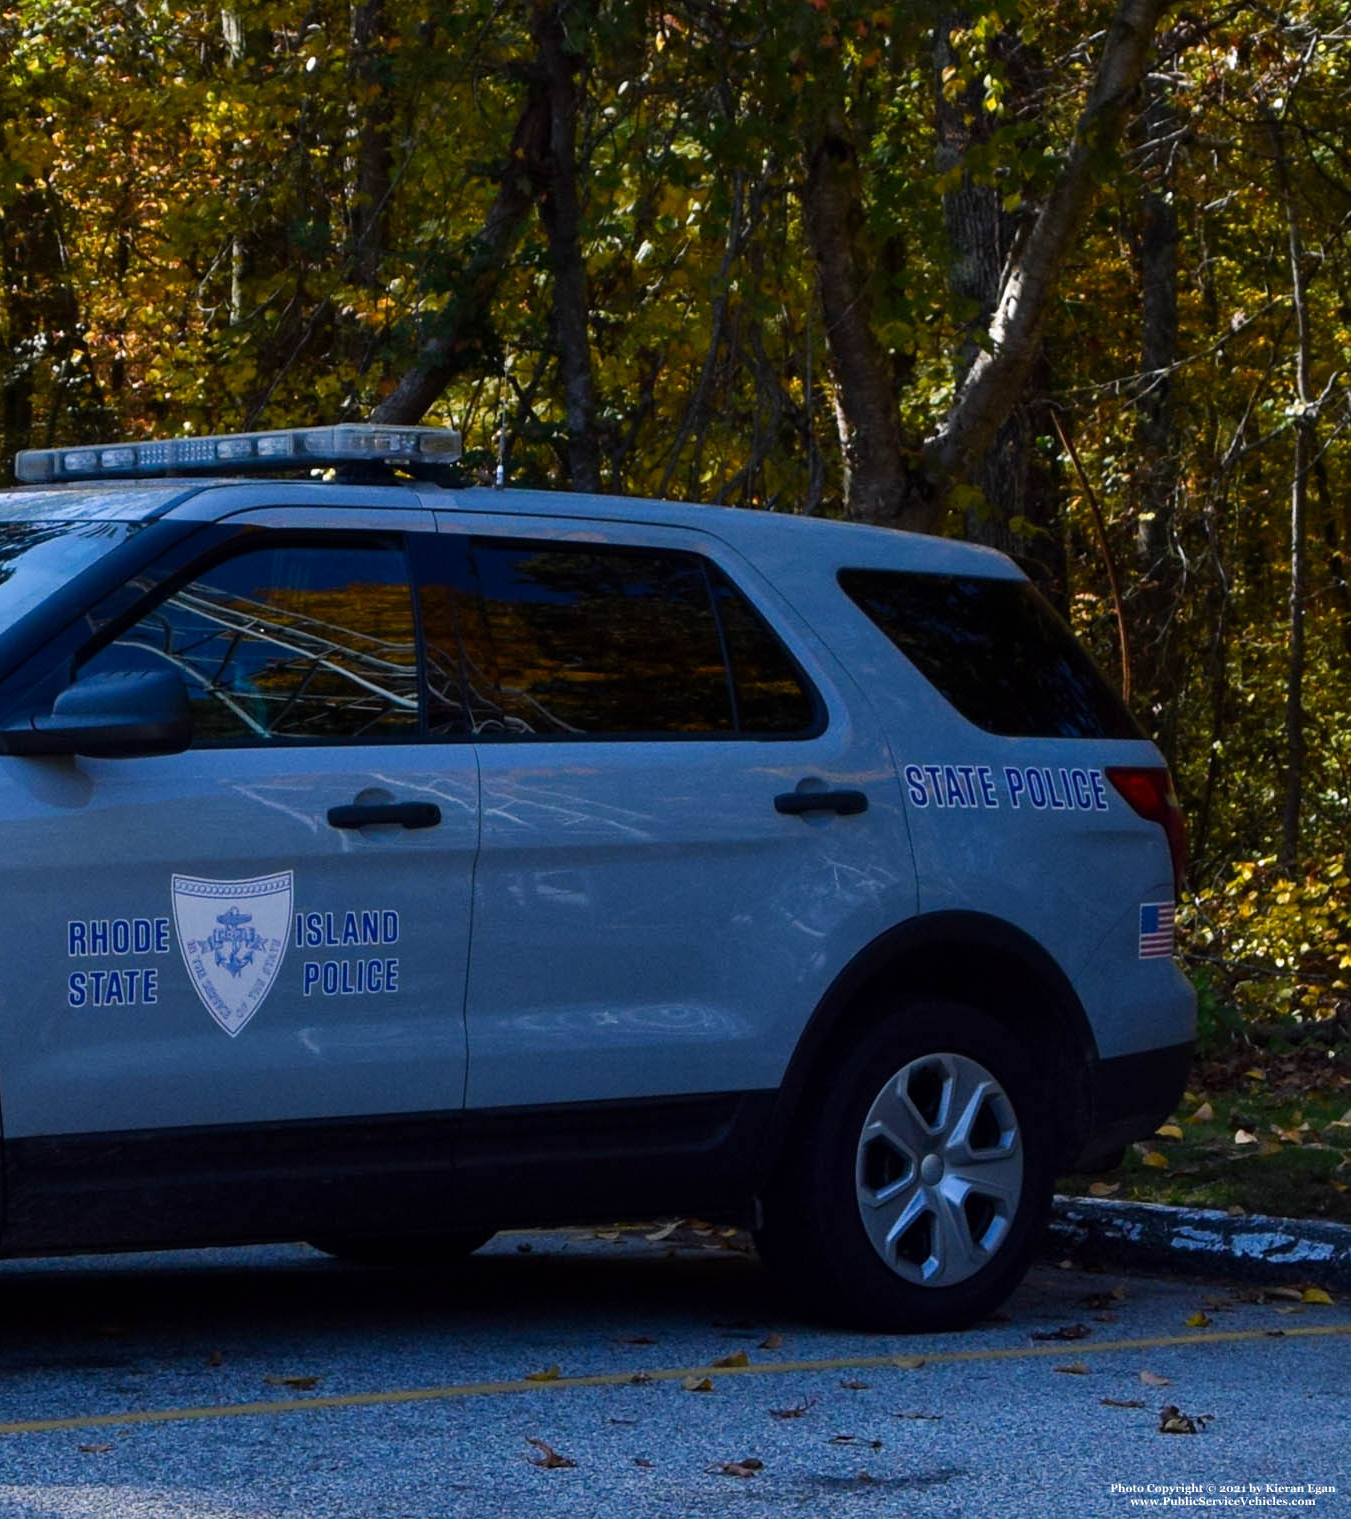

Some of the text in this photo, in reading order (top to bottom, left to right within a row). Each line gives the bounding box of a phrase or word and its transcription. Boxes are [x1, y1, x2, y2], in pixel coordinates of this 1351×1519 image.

[904, 764, 1109, 812] STATE POLICE
[67, 918, 170, 957] RHODE
[295, 909, 400, 948] ISLAND
[67, 968, 158, 1008] STATE
[303, 958, 399, 997] POLICE
